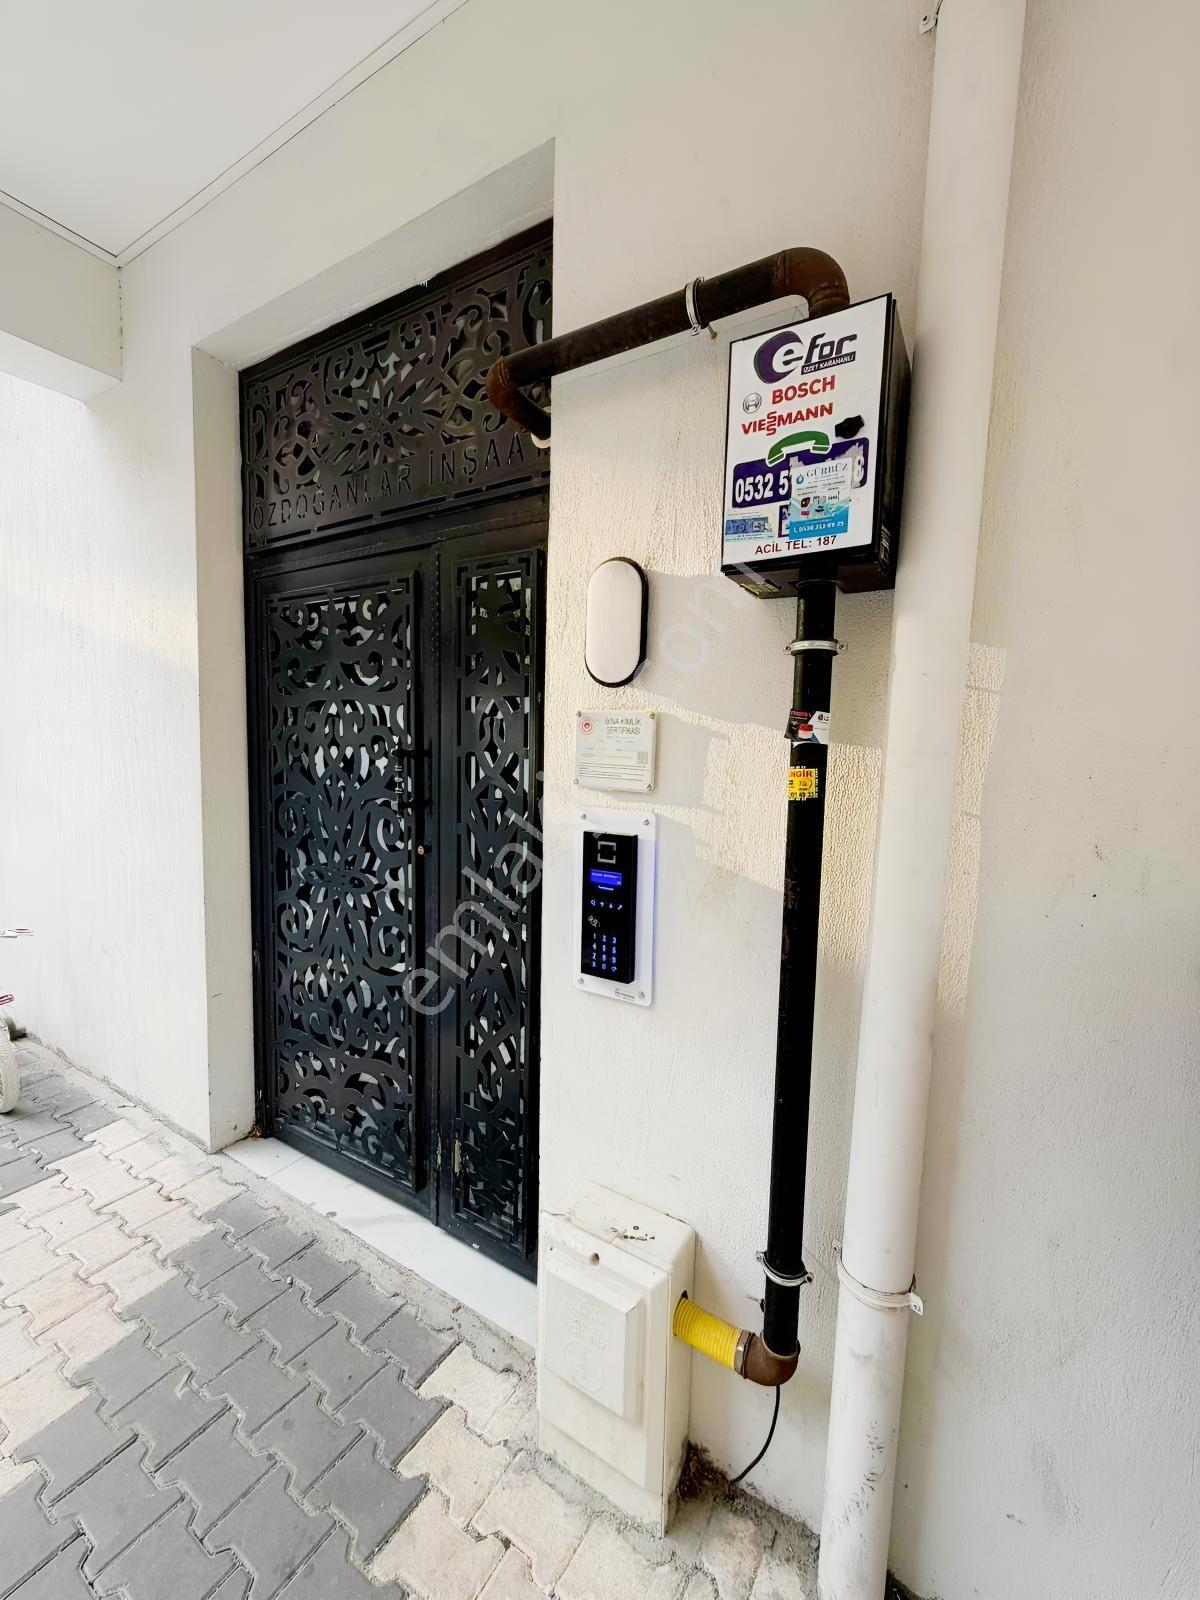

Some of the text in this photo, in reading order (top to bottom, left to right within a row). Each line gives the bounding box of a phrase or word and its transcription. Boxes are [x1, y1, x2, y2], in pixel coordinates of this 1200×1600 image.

[771, 375, 836, 405] BOSCH
[430, 432, 541, 484] İNŞAA
[735, 472, 774, 504] 0532
[755, 535, 837, 555] ACİL TEL: 187
